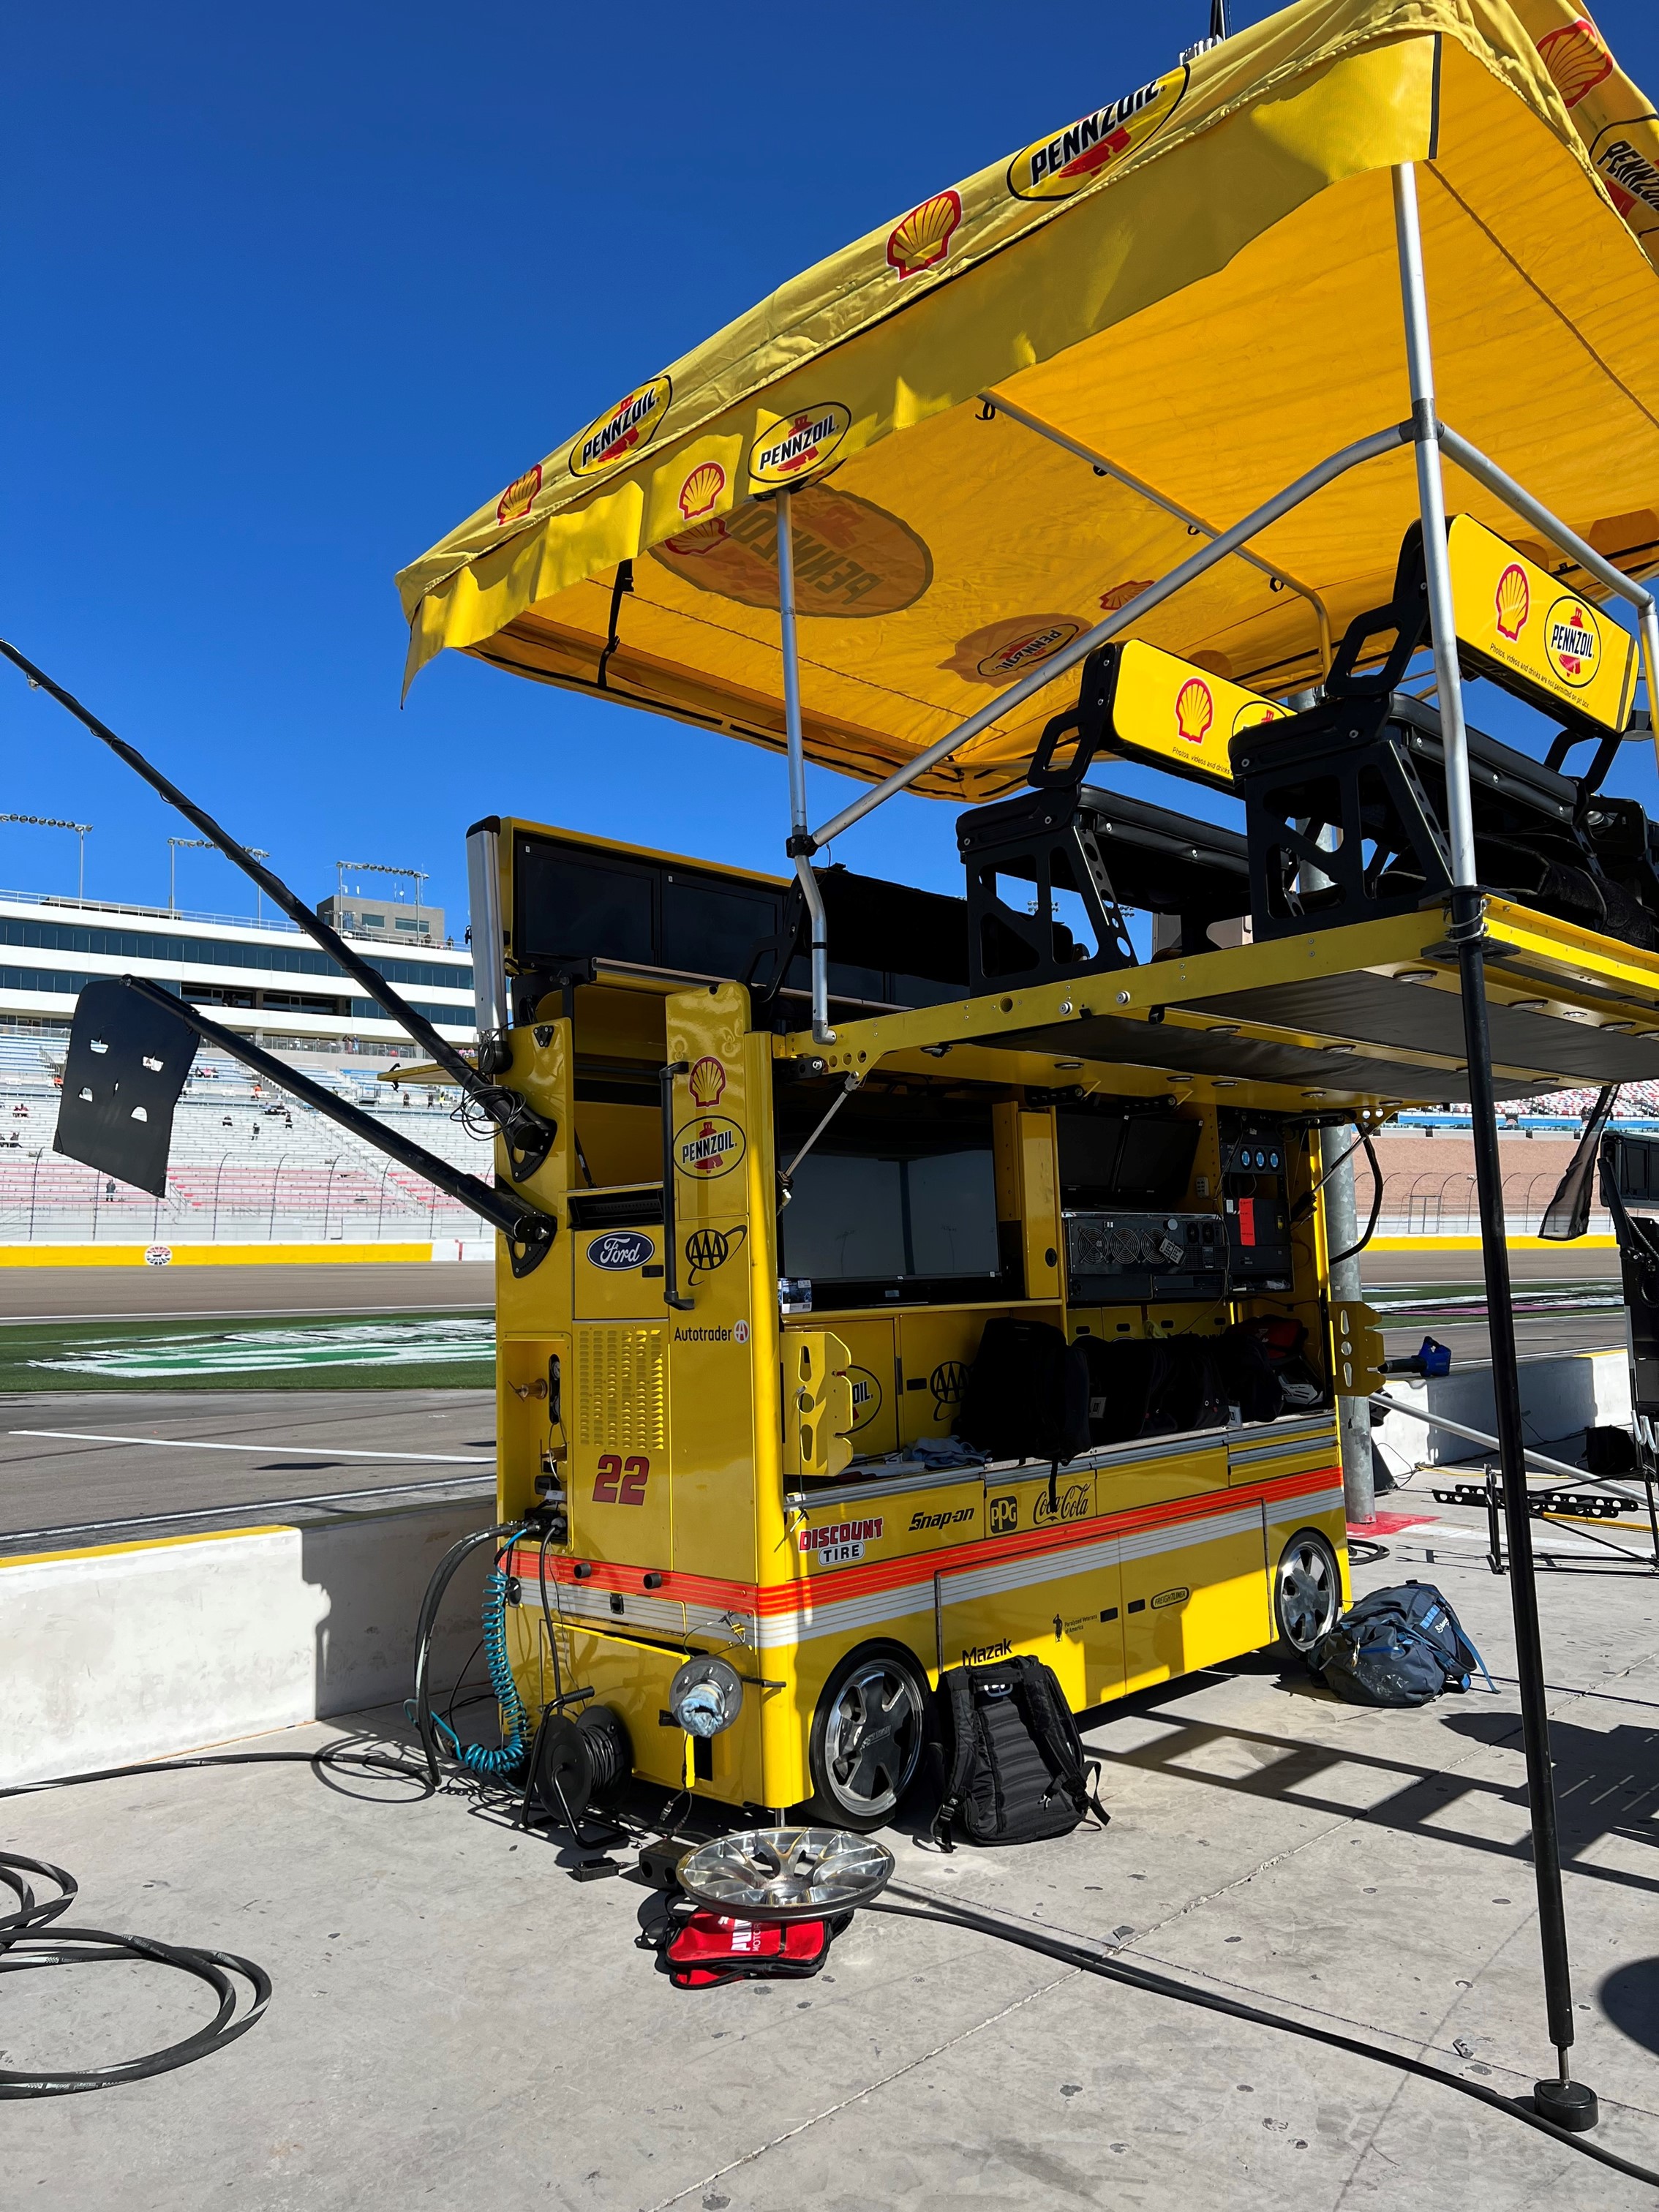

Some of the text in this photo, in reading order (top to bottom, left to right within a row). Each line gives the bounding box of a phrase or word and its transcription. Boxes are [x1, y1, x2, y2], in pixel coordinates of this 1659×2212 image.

[582, 387, 656, 467] PENNZOIL
[759, 414, 838, 471] PENNZOIL
[1551, 624, 1593, 658] PENNZOIL
[1490, 642, 1505, 659] Photos,
[1507, 654, 1520, 667] videos
[1520, 663, 1528, 672] and
[1528, 666, 1540, 680] drinks
[1172, 746, 1190, 760] Photos,
[1191, 754, 1206, 766] videos
[1207, 761, 1216, 770] and
[1216, 764, 1230, 775] drinks
[682, 1130, 734, 1165] PENNZOIL
[600, 1238, 642, 1263] Ford
[690, 1230, 726, 1269] AAA
[674, 1326, 731, 1342] Autotrader
[592, 1453, 650, 1506] 22
[908, 1507, 974, 1532] Snap-on
[992, 1497, 1017, 1530] PPG
[800, 1517, 883, 1551] DISCOUNT
[824, 1544, 859, 1562] TIRE
[1154, 1590, 1186, 1607] FREIGHTLINER
[1083, 1614, 1097, 1622] Veterans
[962, 1638, 1012, 1666] Mazak
[731, 1919, 752, 1952] PUM
